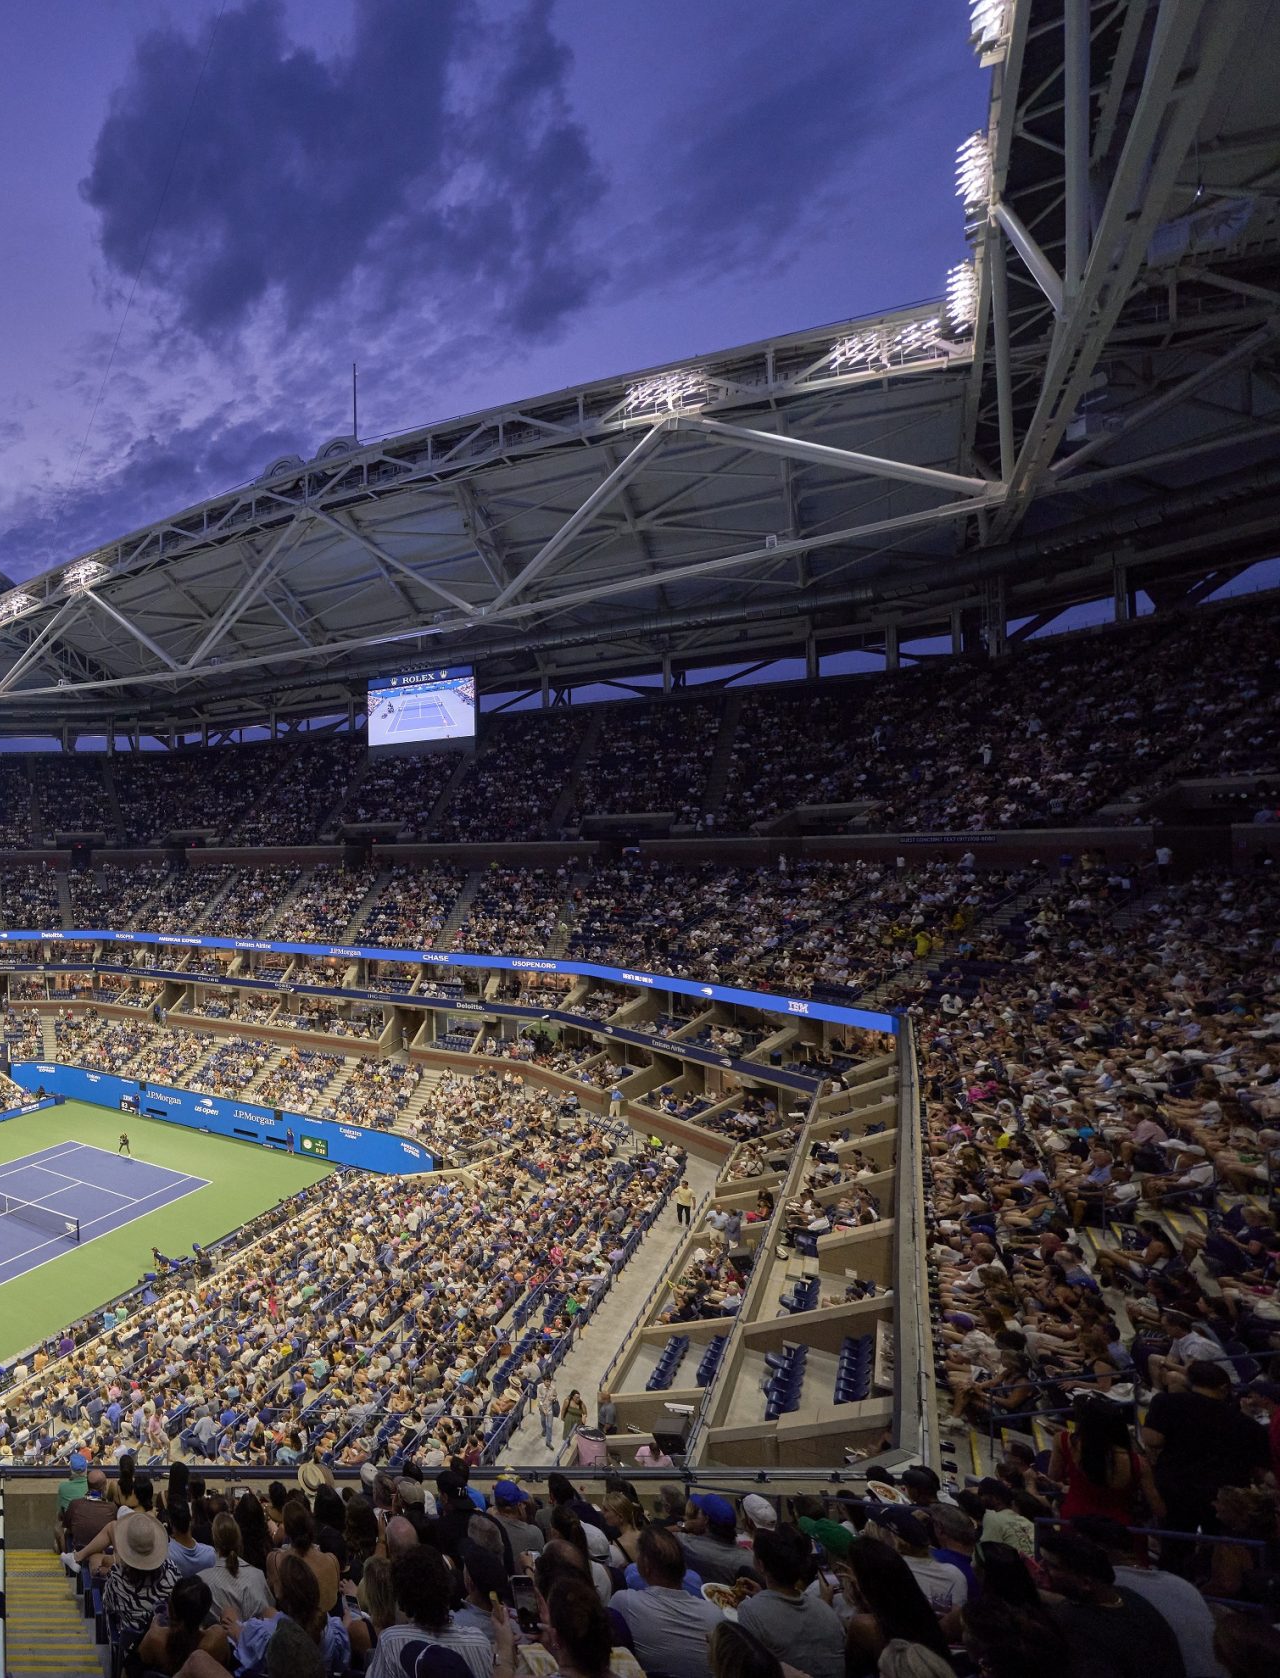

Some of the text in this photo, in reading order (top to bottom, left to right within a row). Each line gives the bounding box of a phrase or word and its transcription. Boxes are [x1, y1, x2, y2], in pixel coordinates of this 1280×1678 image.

[402, 683, 435, 694] ROLEX
[329, 947, 361, 957] J.P.Morgan
[422, 954, 449, 962] CHASE
[512, 960, 557, 969] USOPEN.ORG
[456, 1002, 485, 1011] Deloitte.
[787, 1001, 809, 1014] IBM
[651, 1039, 686, 1054] Emirates Airline
[146, 1090, 182, 1105] J.P.Morgan
[202, 1107, 219, 1116] open
[233, 1109, 275, 1126] J.P.Morgan
[339, 1127, 362, 1137] Emirates
